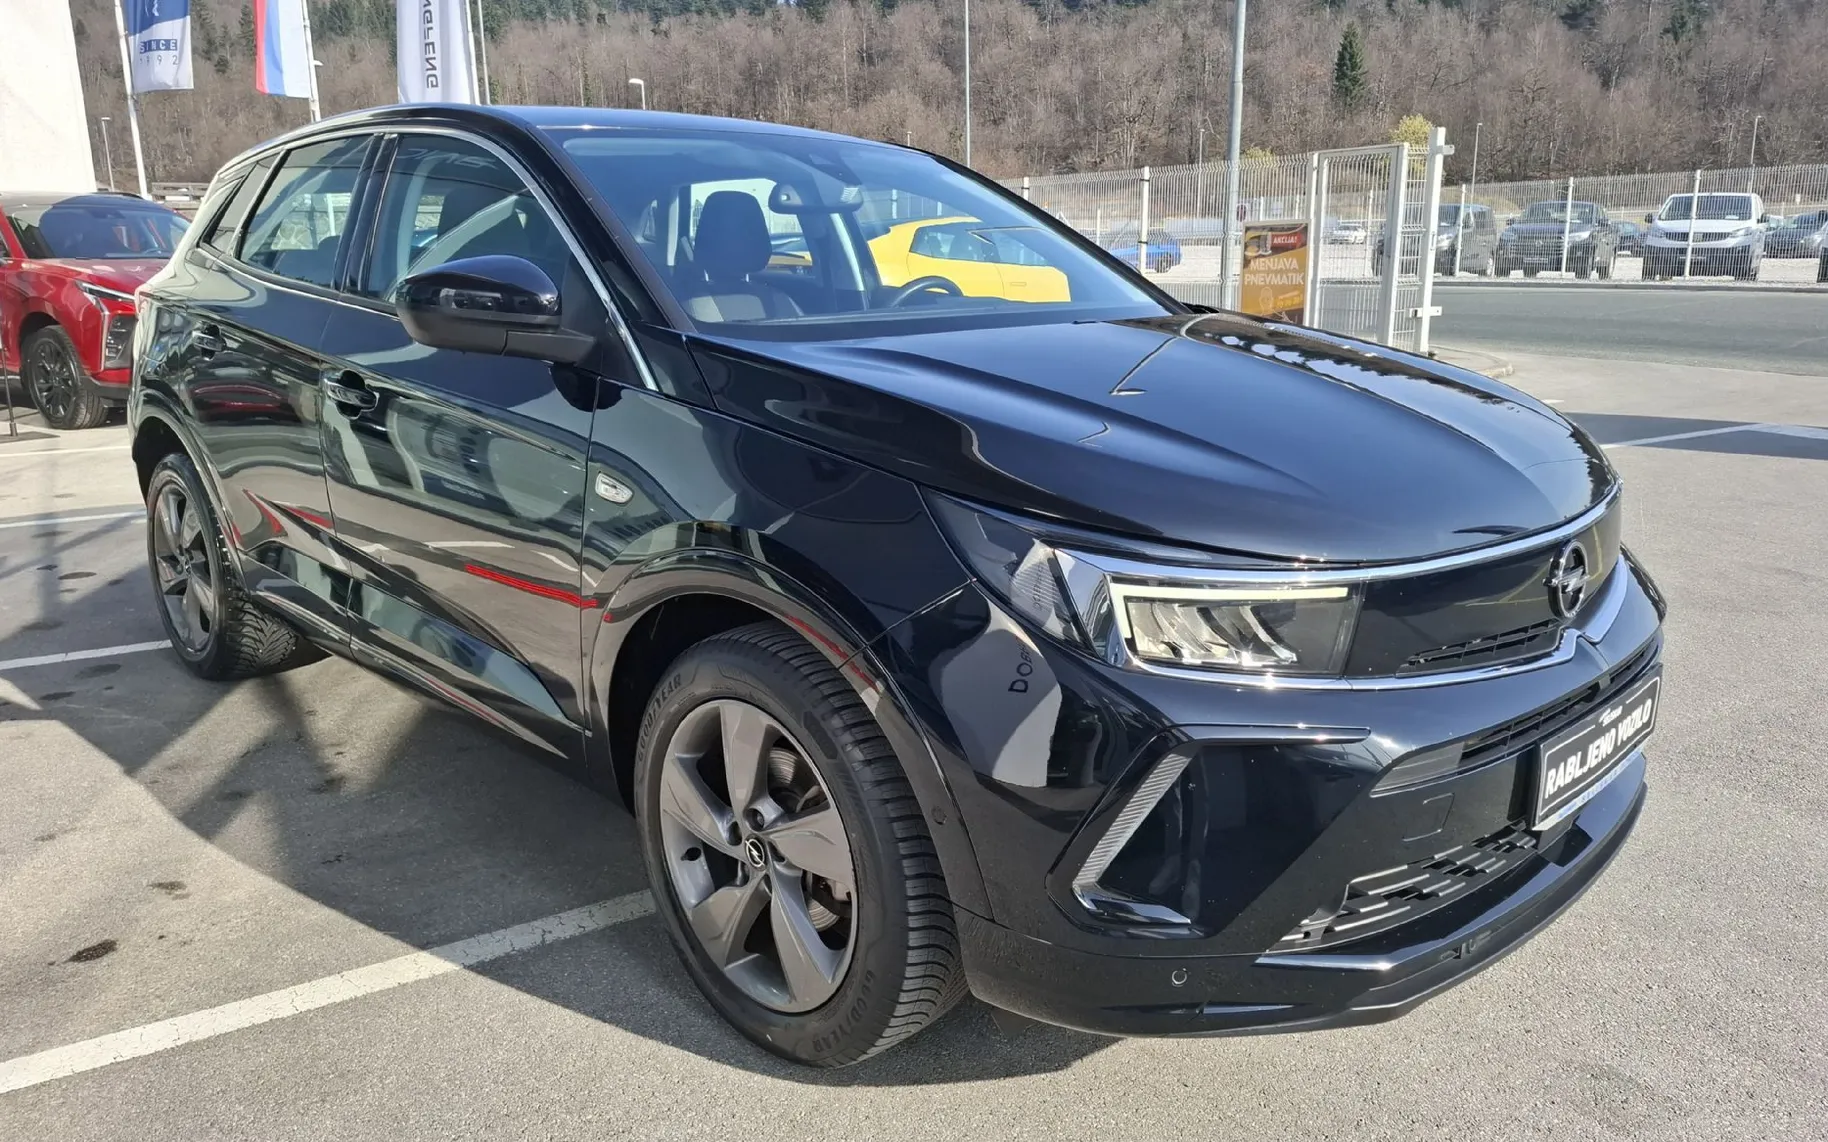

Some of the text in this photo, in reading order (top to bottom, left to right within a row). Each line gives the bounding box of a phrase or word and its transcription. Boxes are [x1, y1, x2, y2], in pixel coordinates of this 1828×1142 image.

[139, 40, 177, 53] SINCE
[1250, 257, 1299, 271] MENJAVA
[1244, 272, 1305, 285] PNEVMATIK
[637, 673, 682, 763] GOODYEAR
[1544, 727, 1616, 800] RABLJENO
[1617, 698, 1653, 747] VOZILO
